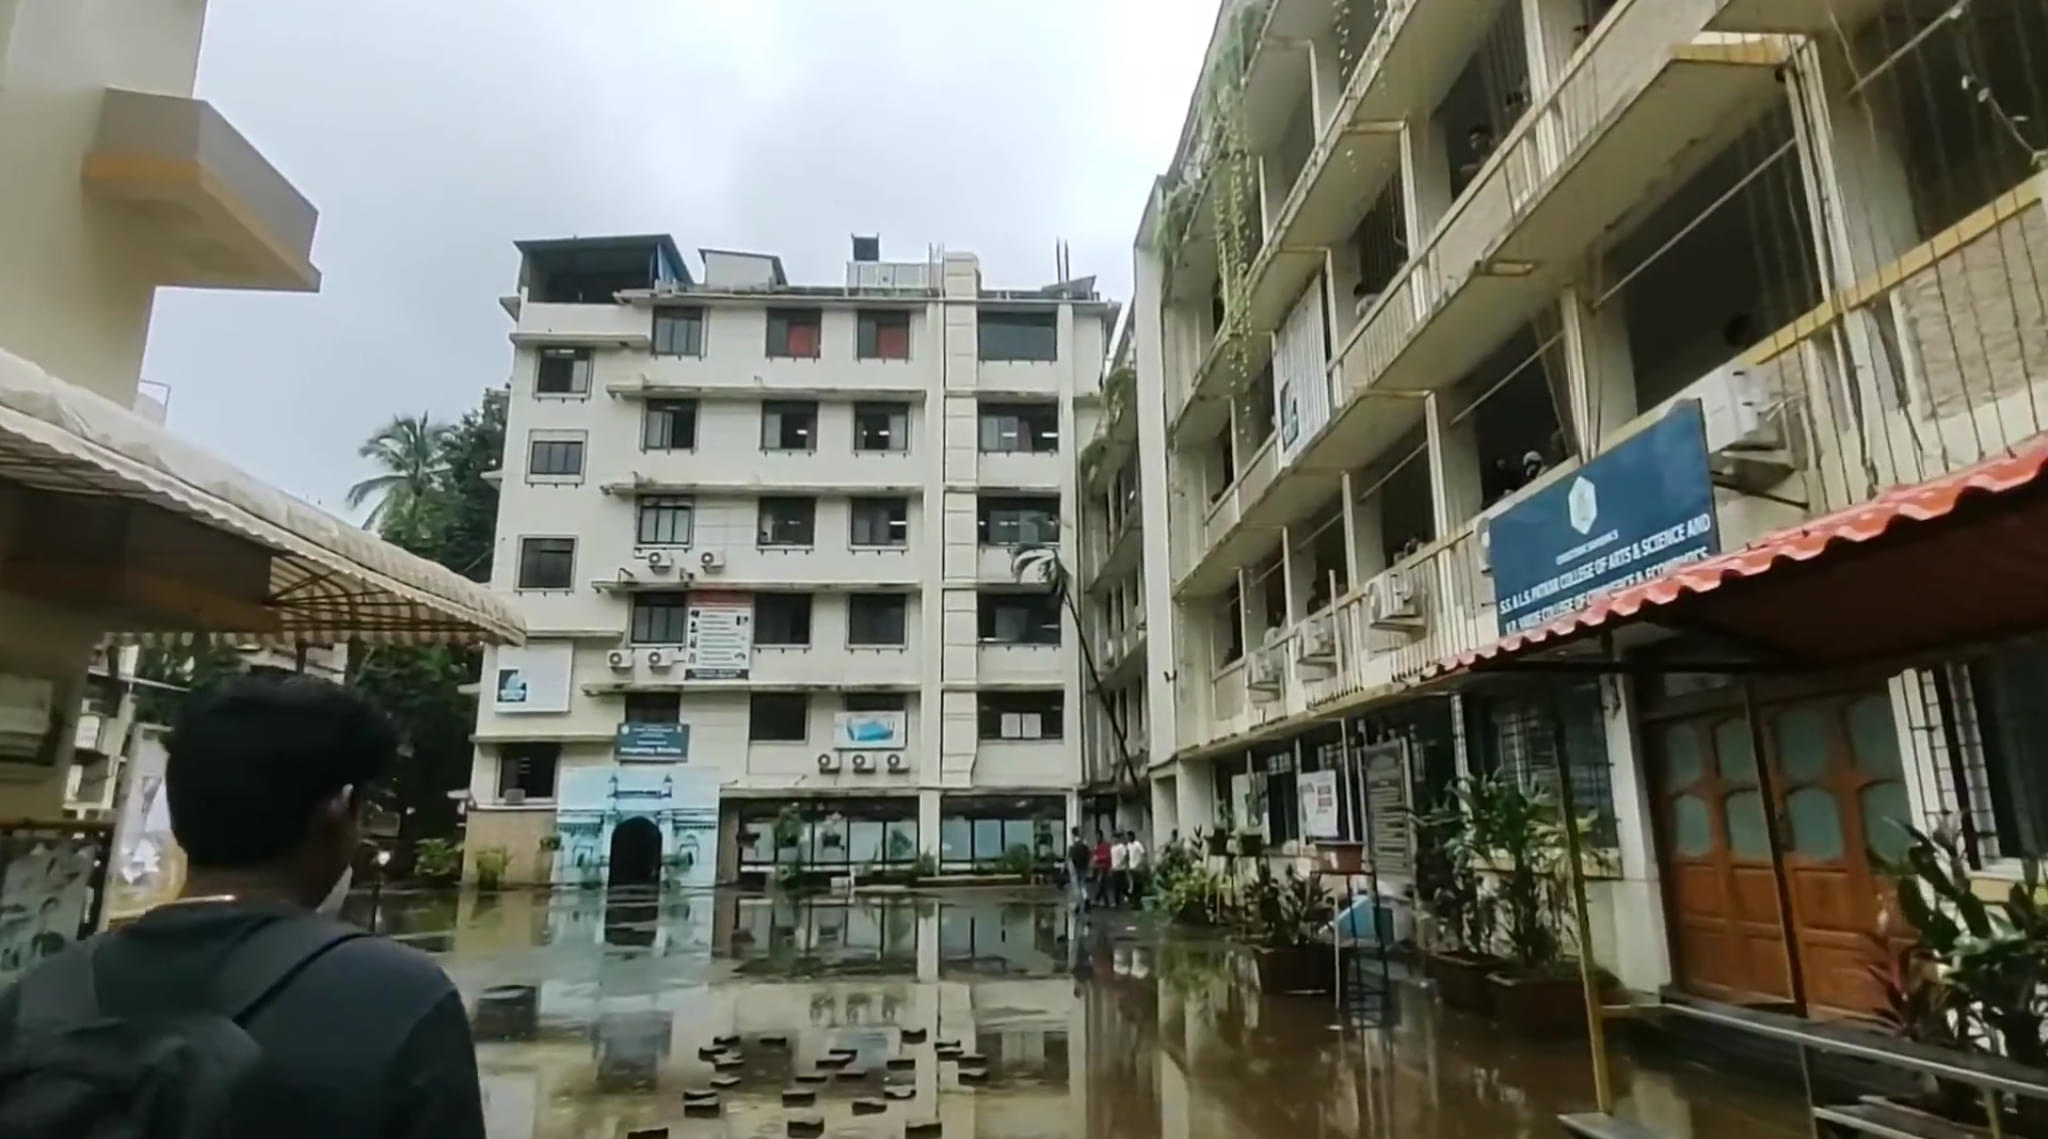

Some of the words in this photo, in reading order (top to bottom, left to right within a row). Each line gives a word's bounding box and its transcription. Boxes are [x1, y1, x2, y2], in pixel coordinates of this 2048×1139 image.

[1560, 561, 1596, 589] COLLEGE
[1595, 556, 1608, 575] OF
[1608, 546, 1632, 570] ARTS
[1632, 542, 1641, 560] &
[1641, 523, 1686, 557] SCIENCE
[1687, 512, 1711, 539] AND
